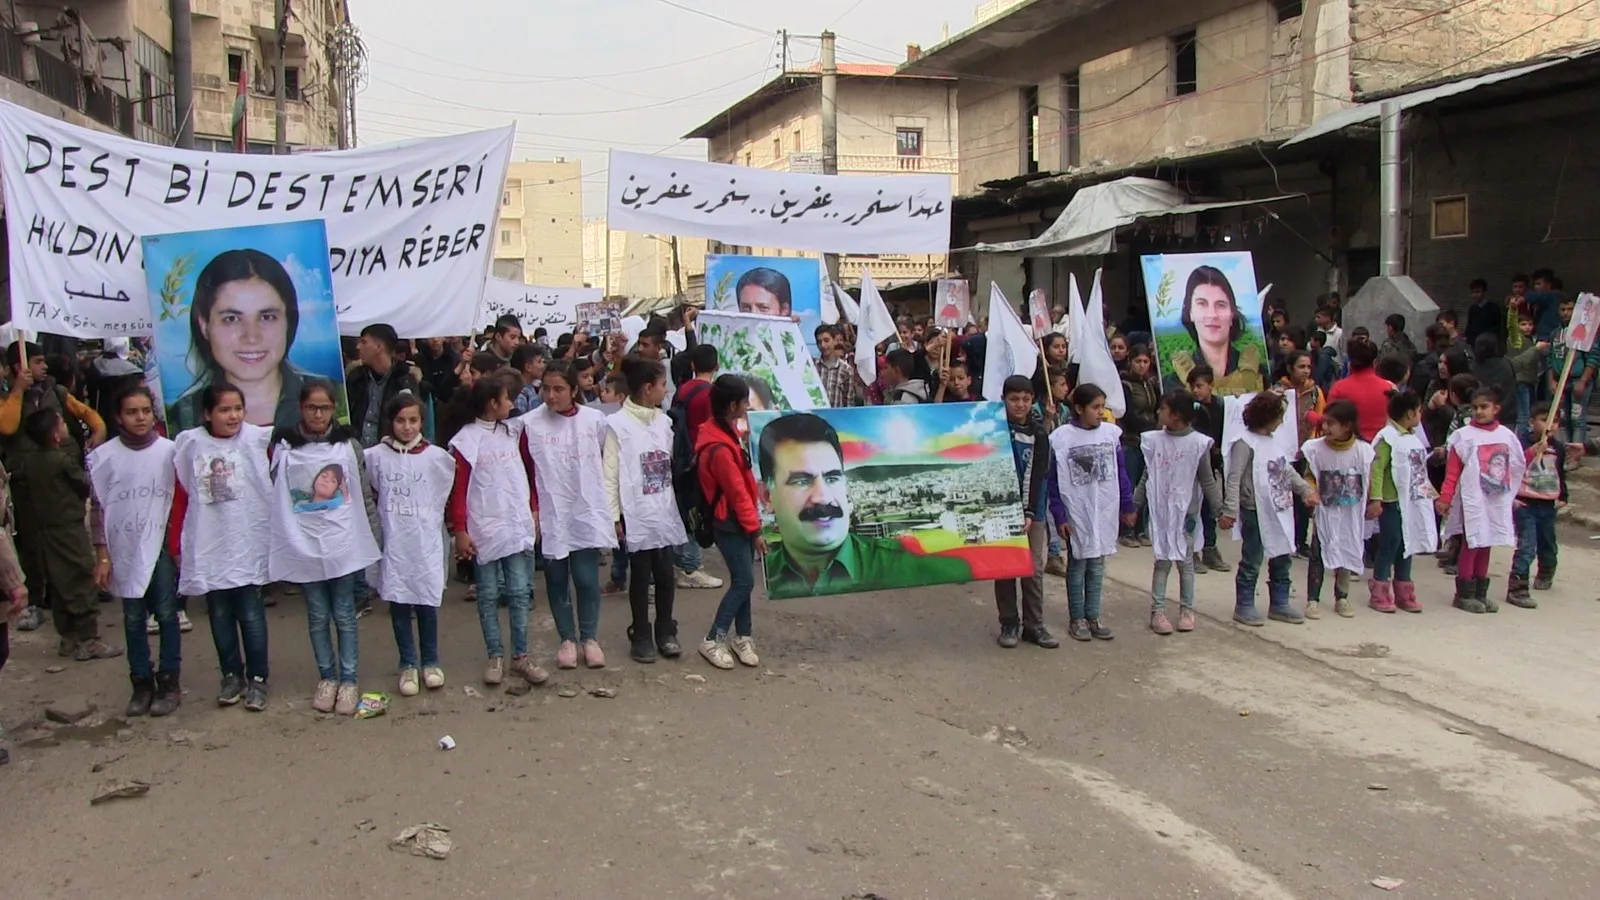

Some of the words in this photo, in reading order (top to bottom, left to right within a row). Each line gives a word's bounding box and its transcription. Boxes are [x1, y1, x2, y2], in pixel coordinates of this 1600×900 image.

[25, 134, 141, 197] DEST
[227, 171, 335, 211] DEST
[64, 280, 131, 302] حلب
